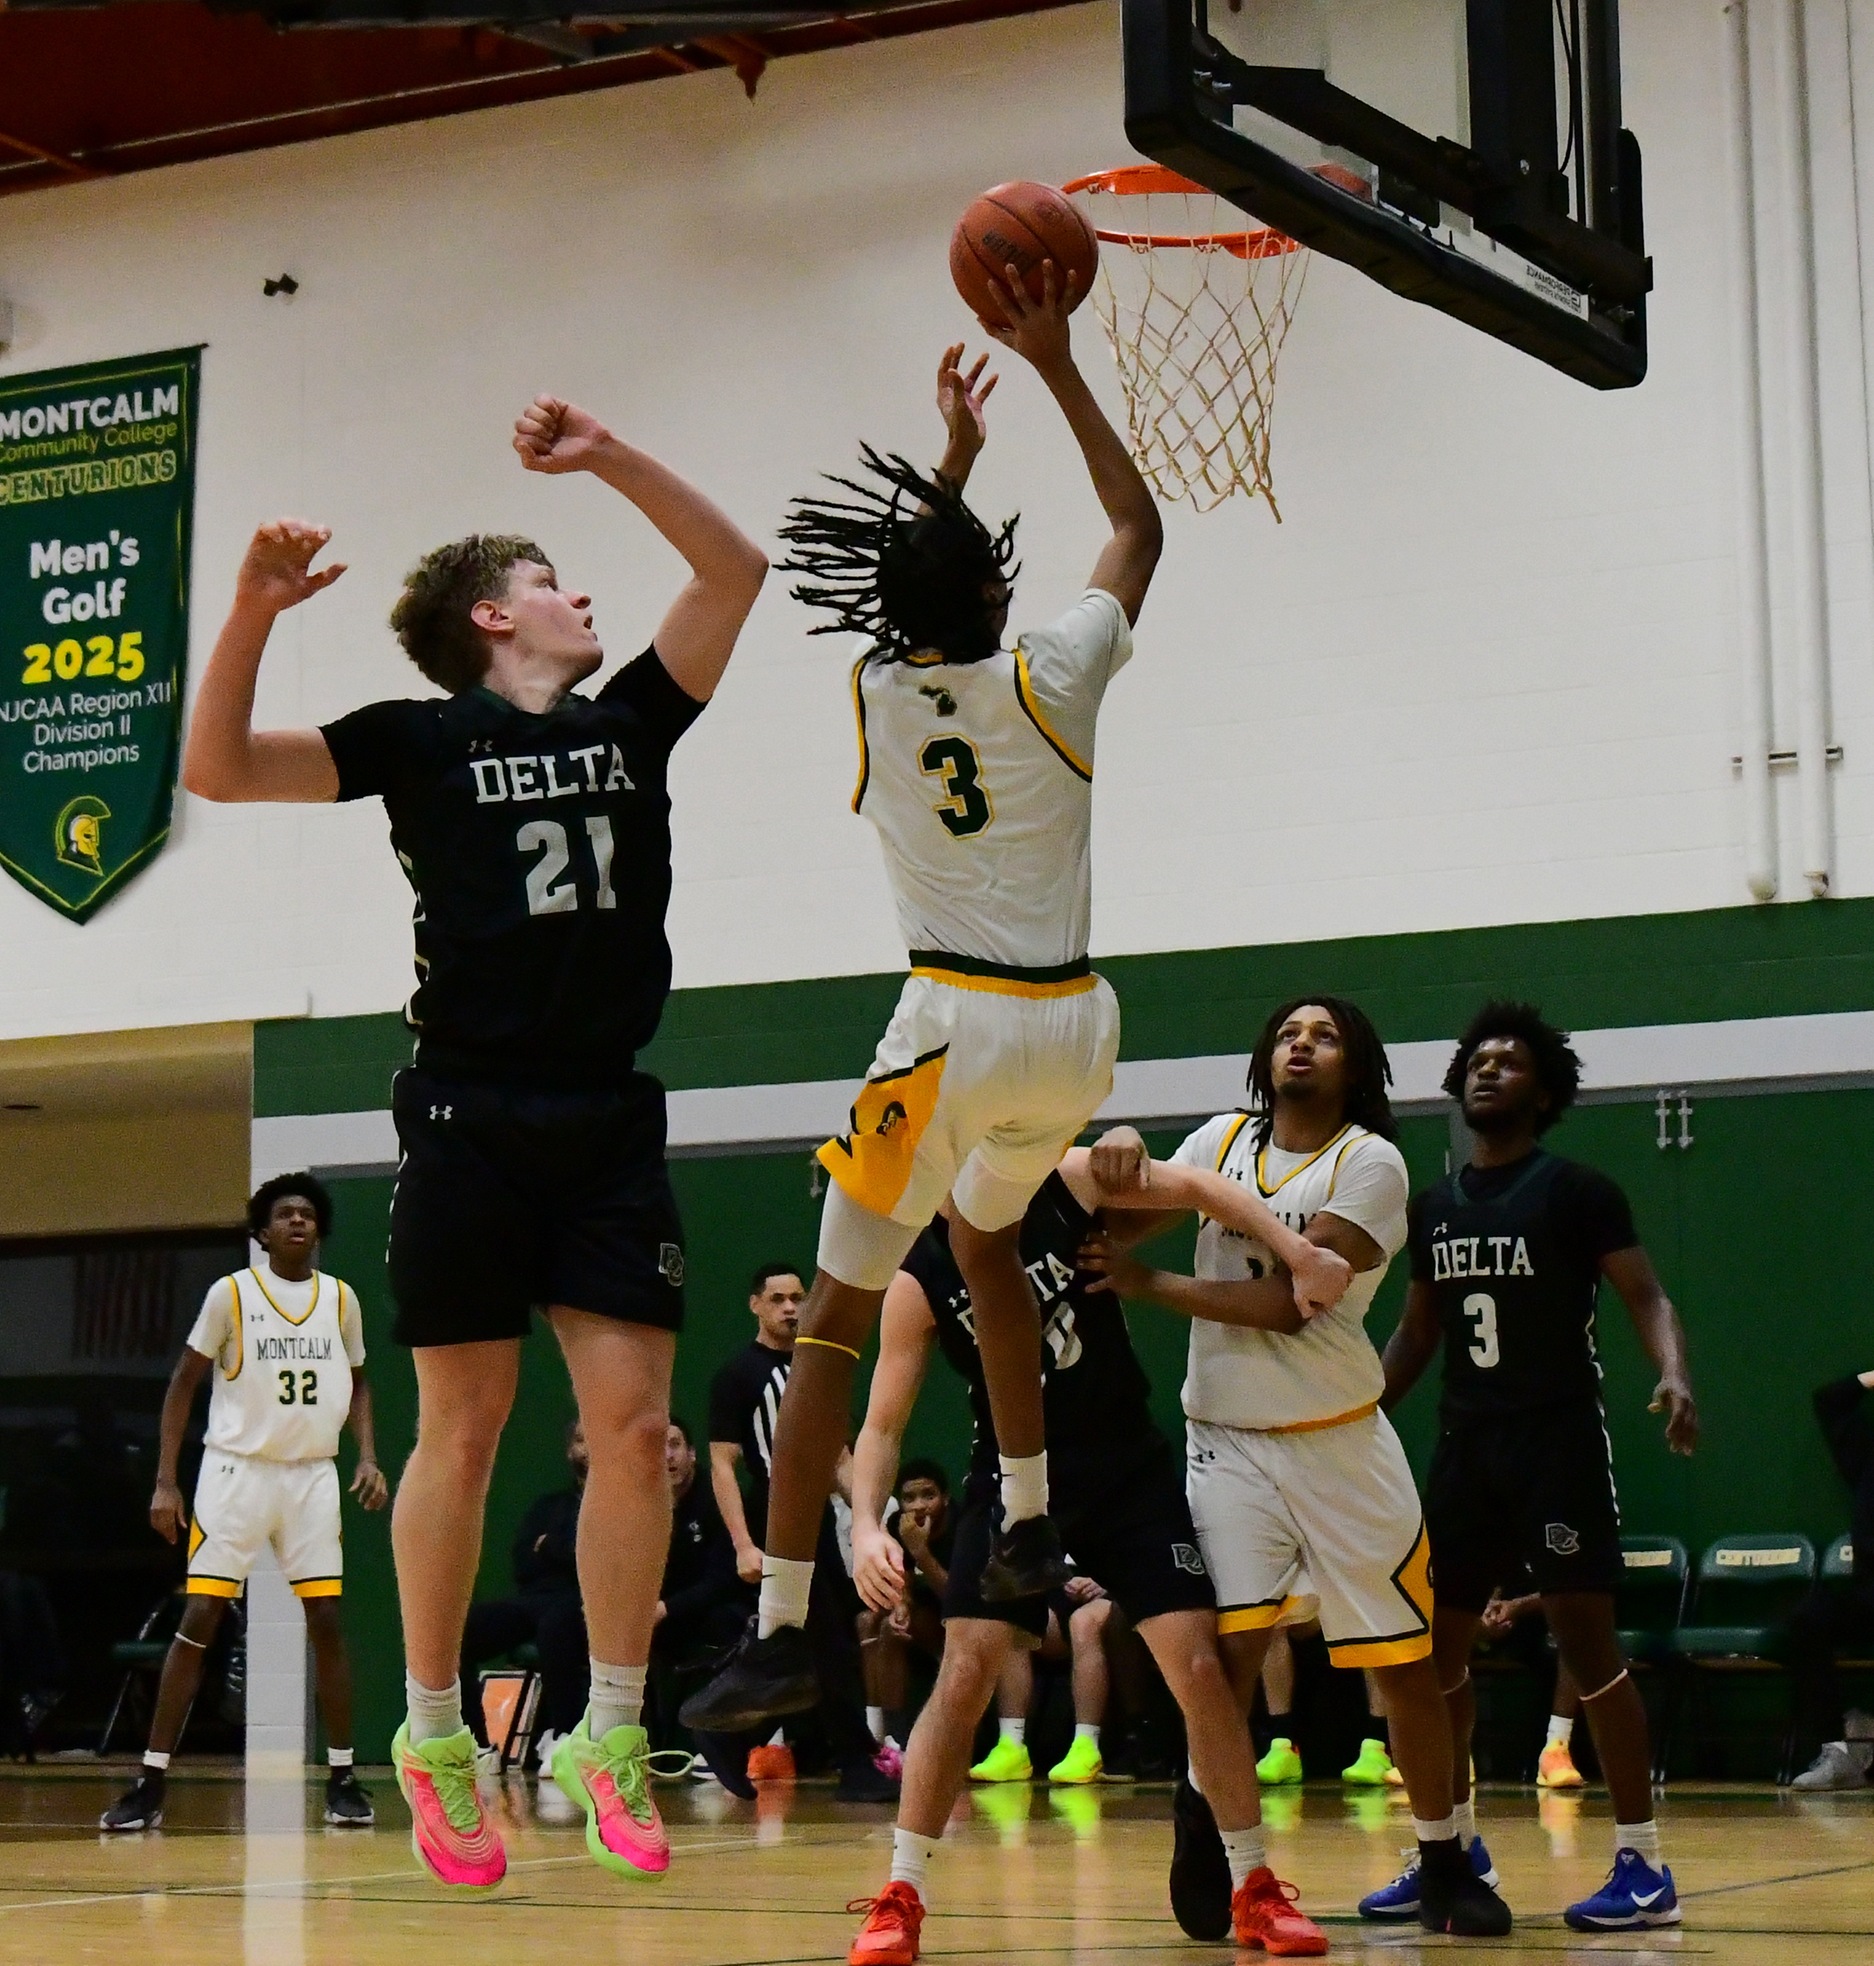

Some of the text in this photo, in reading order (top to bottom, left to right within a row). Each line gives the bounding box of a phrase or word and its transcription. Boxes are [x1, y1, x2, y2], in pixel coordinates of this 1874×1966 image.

[0, 385, 179, 442] MONTCALM
[105, 421, 177, 447] College
[30, 530, 140, 579] Men's
[42, 578, 127, 624] Golf
[22, 631, 145, 684] 2025
[71, 687, 142, 718] Region
[146, 682, 171, 705] XII
[35, 715, 130, 746] Division II
[23, 744, 139, 773] Champions
[469, 743, 636, 804] DELTA
[917, 732, 995, 841] 3
[516, 815, 617, 916] 21
[1432, 1237, 1535, 1282] DELTA
[256, 1337, 332, 1361] MONTCALM
[1463, 1293, 1500, 1368] 3
[278, 1370, 318, 1405] 32
